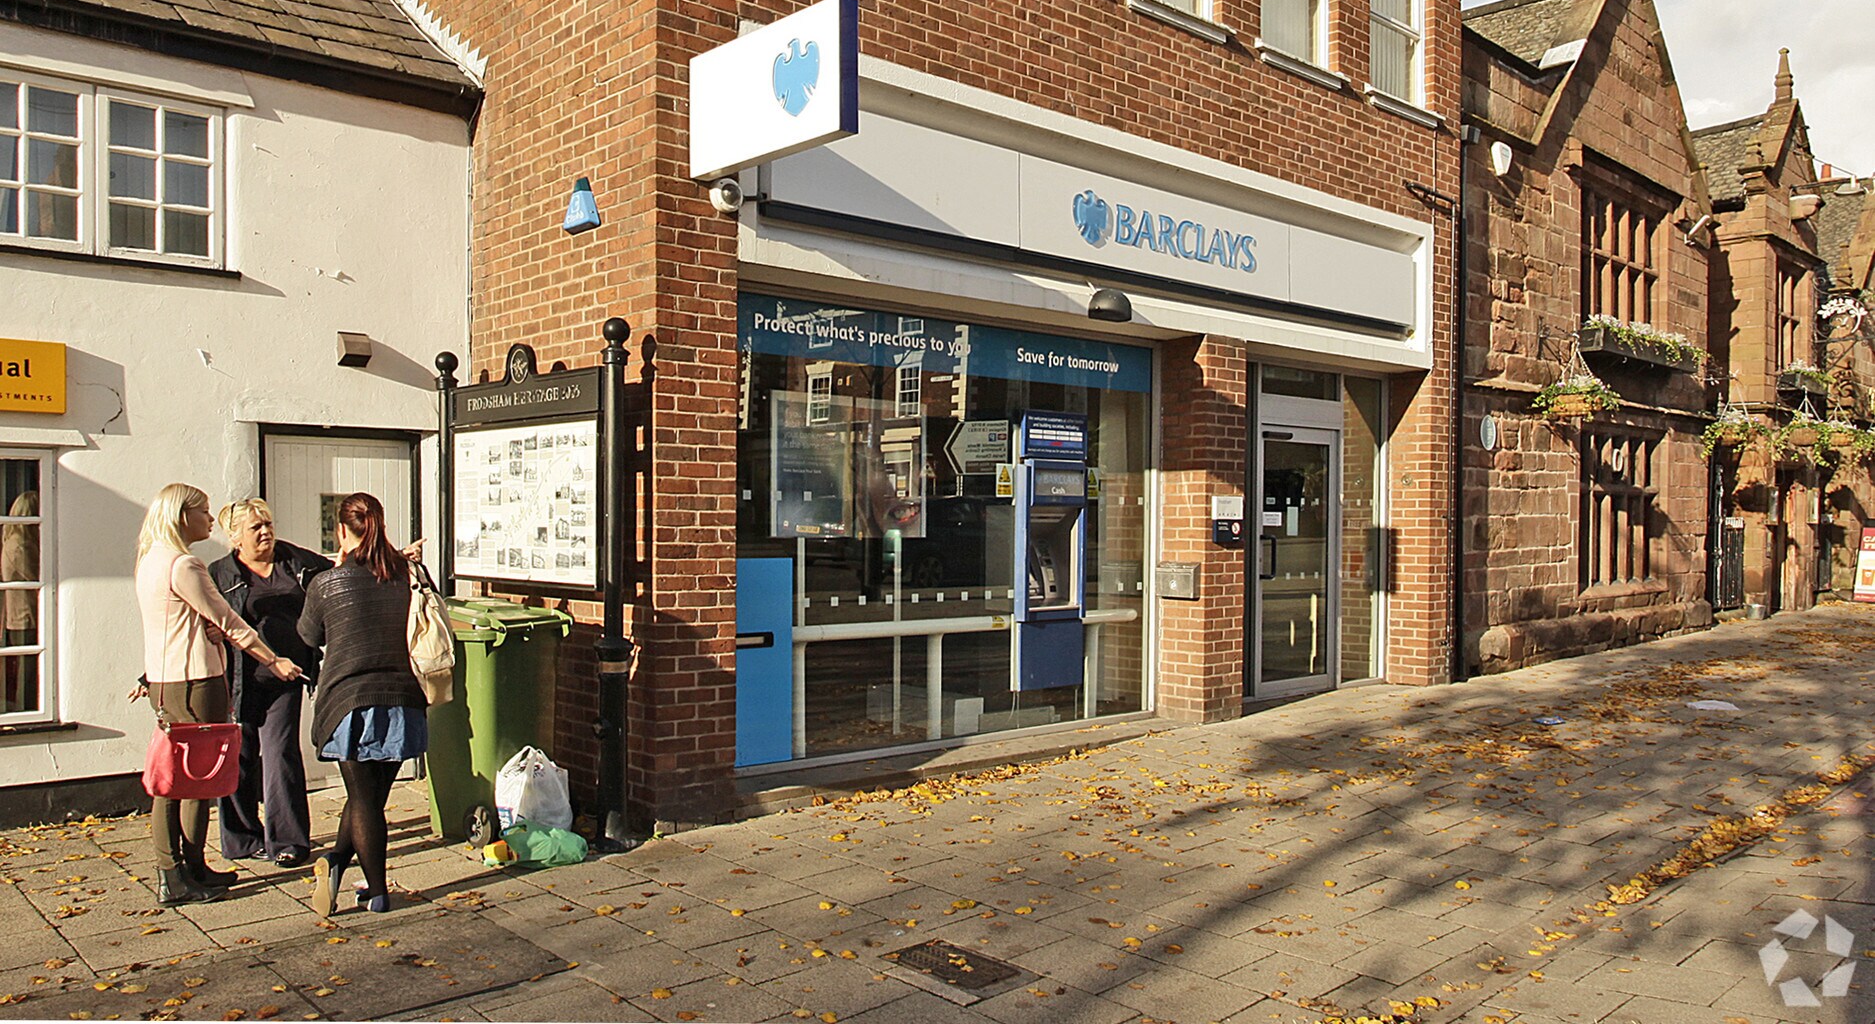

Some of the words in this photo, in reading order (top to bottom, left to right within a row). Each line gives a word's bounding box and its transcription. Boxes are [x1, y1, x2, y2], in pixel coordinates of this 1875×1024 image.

[1114, 203, 1257, 274] BARCLAYS
[754, 312, 811, 336] Protect
[816, 324, 865, 342] what's
[869, 330, 926, 350] precious
[930, 336, 944, 352] to
[948, 340, 971, 357] you
[0, 358, 32, 378] al
[1017, 347, 1045, 365] Save
[1048, 351, 1064, 368] for
[1067, 355, 1119, 373] tomorrow
[467, 393, 512, 412] FRODSHAM
[513, 386, 559, 406] HERITAGE
